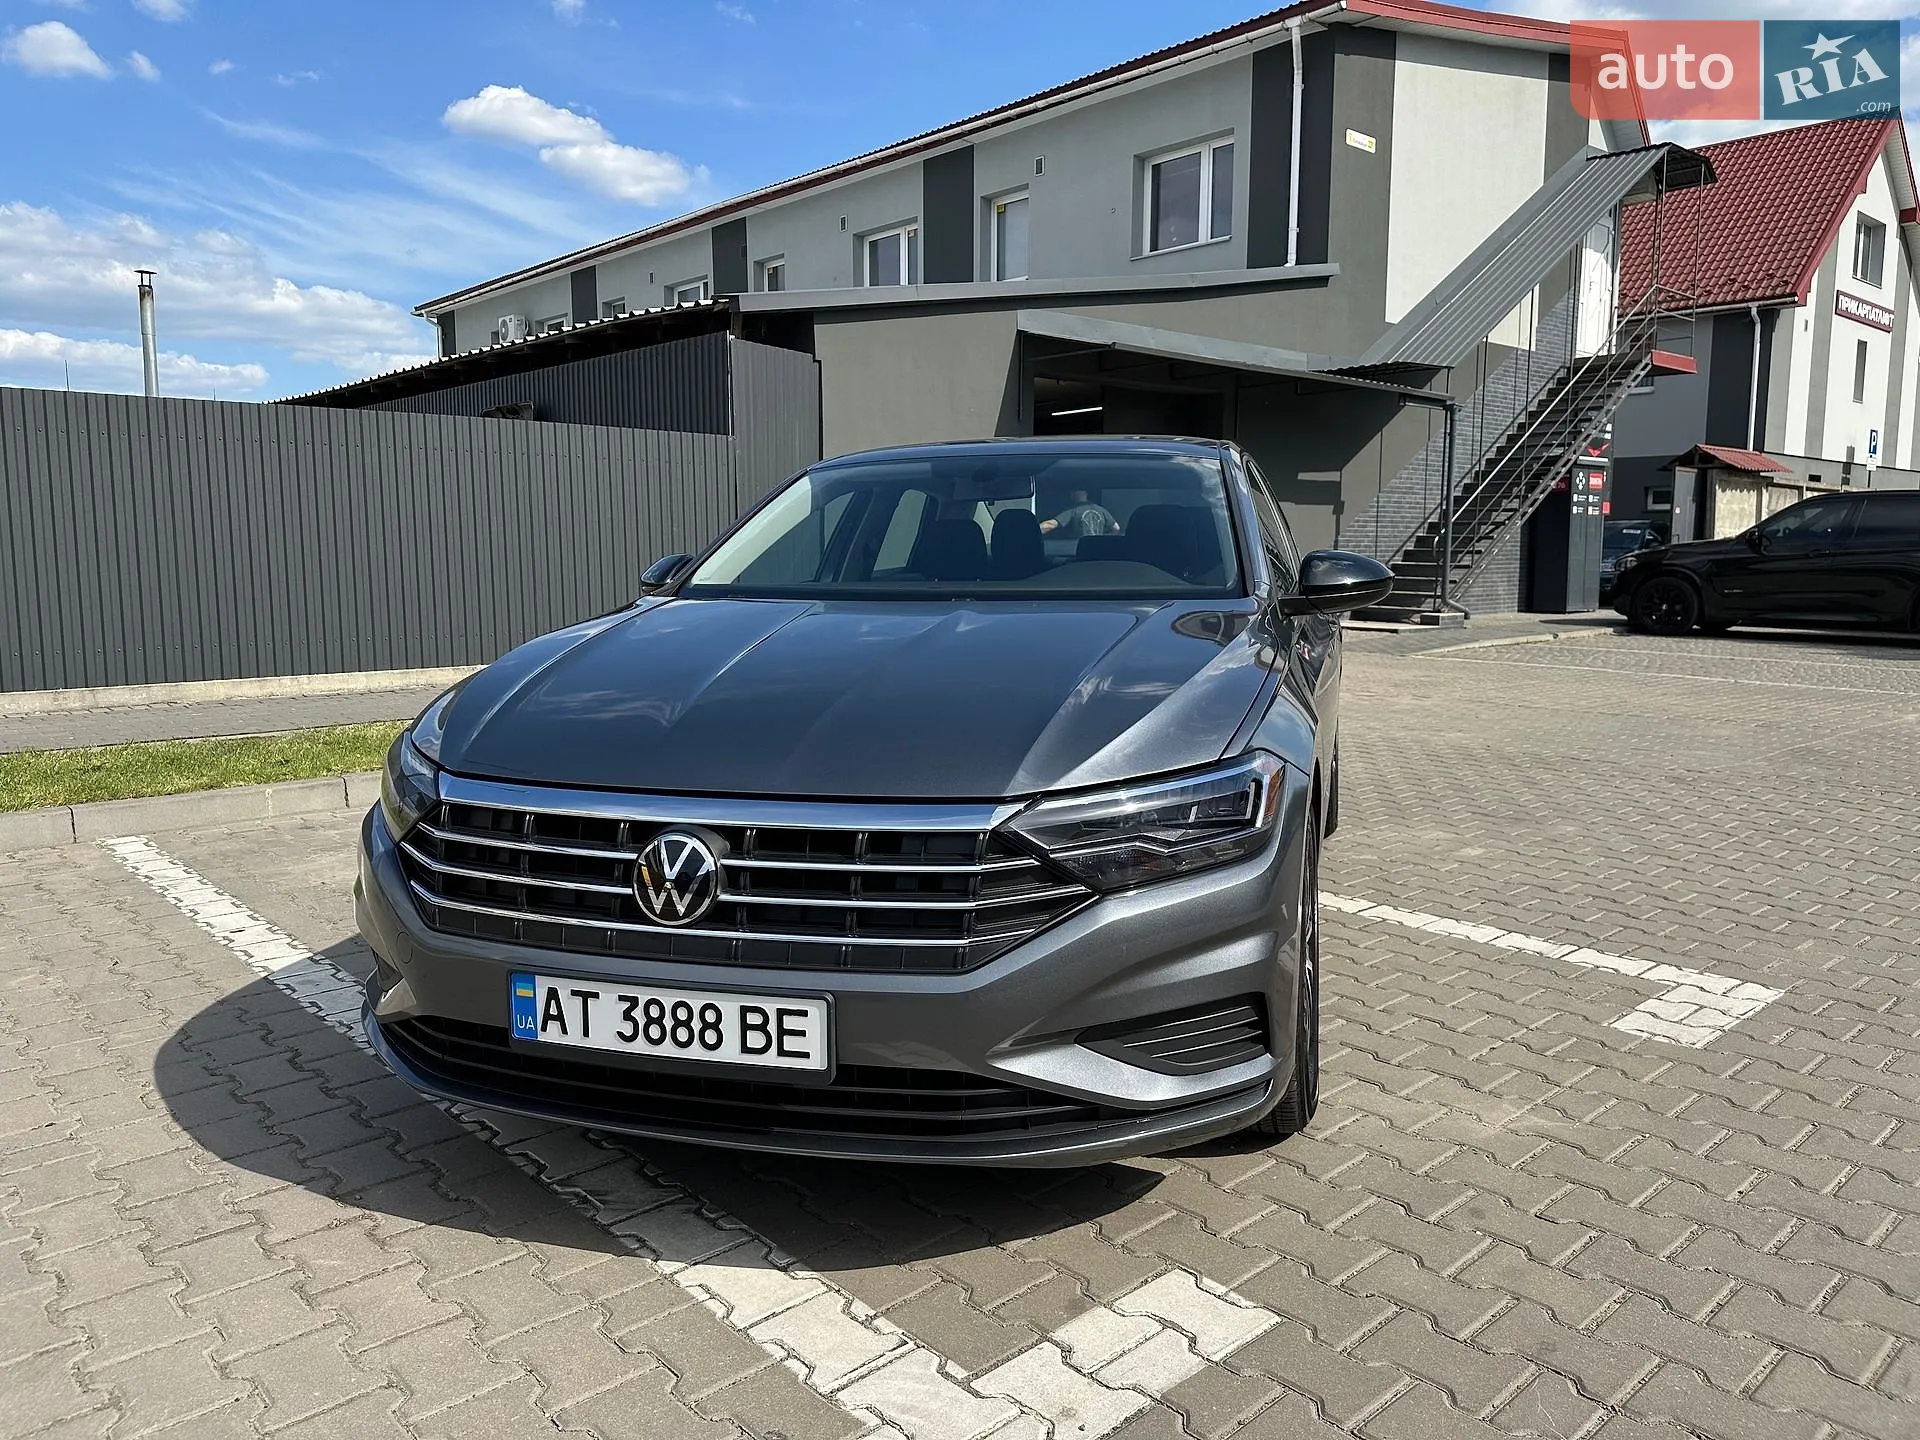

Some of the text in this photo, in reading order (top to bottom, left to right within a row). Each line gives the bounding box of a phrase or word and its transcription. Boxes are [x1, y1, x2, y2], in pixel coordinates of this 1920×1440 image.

[516, 1014, 536, 1031] UA
[540, 986, 811, 1059] AT 3888 BE
